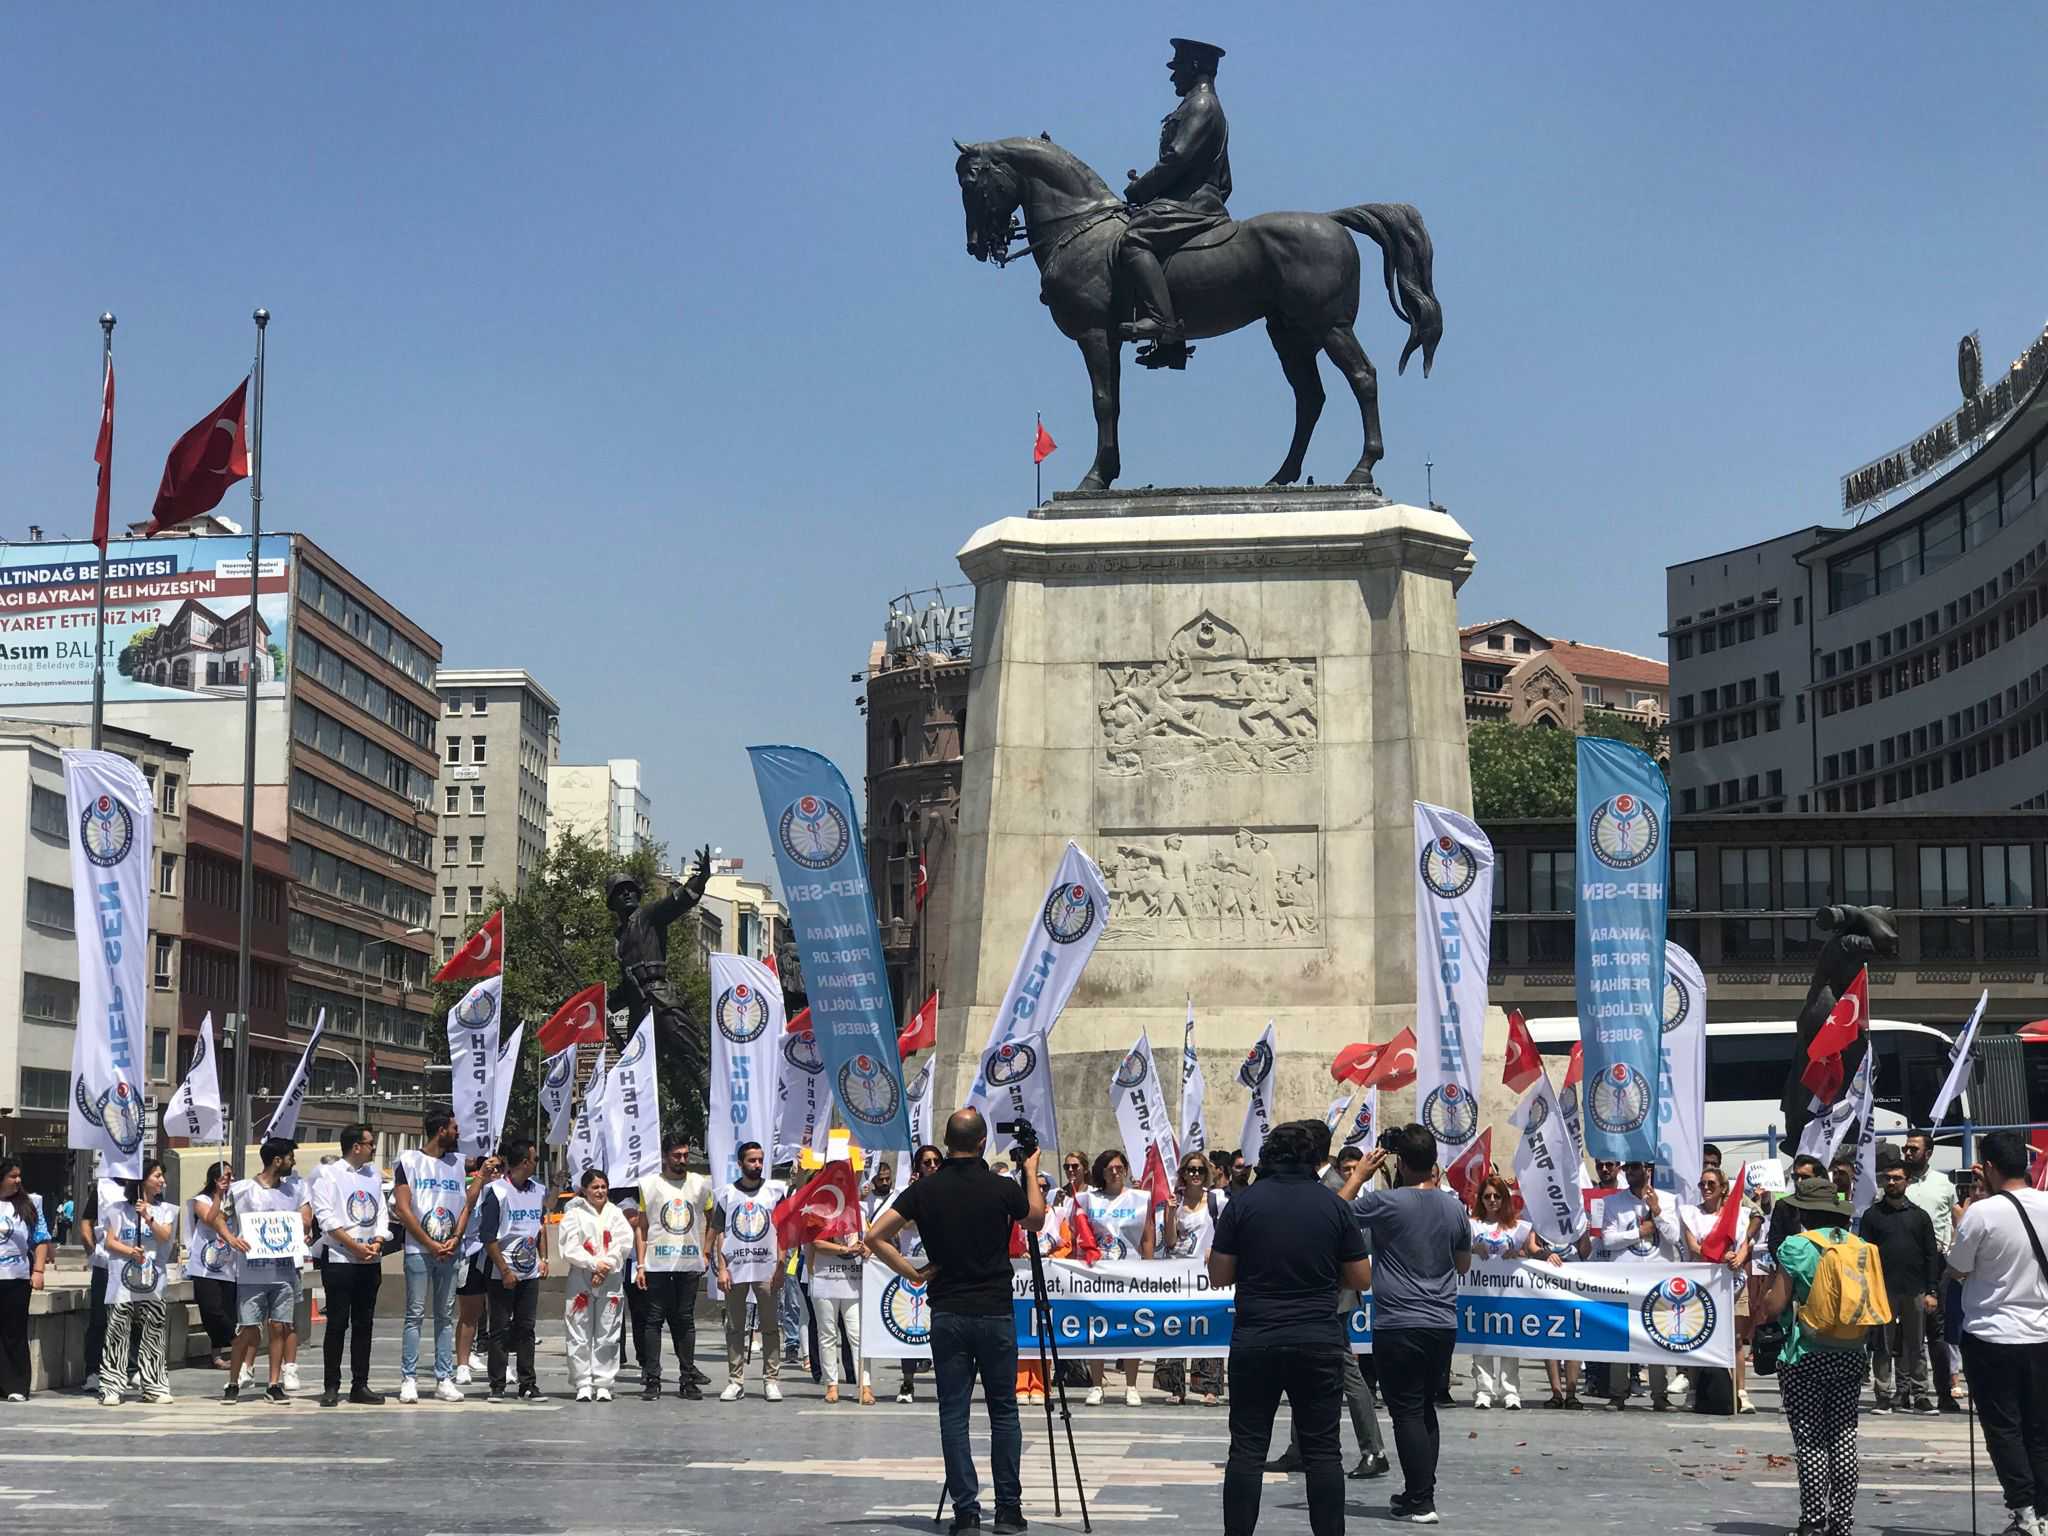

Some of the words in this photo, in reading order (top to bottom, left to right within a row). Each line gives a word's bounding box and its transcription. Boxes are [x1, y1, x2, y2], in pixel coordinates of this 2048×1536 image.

[80, 561, 170, 580] BEEDİYESİ
[0, 592, 22, 606] ACI
[27, 587, 94, 604] BAYRAM
[0, 615, 56, 632] YARET
[132, 608, 161, 624] Mİ?
[508, 1208, 541, 1220] HEP-SE
[654, 1244, 700, 1256] HEP-SEN
[828, 1264, 862, 1273] HEP-SE
[1013, 1274, 1065, 1296] iyaat,
[1069, 1270, 1124, 1294] İnadına
[1128, 1276, 1182, 1294] Adalet!
[1470, 1269, 1524, 1289] Memuru
[1528, 1272, 1571, 1291] Yoksul
[1464, 1304, 1582, 1338] tmez!
